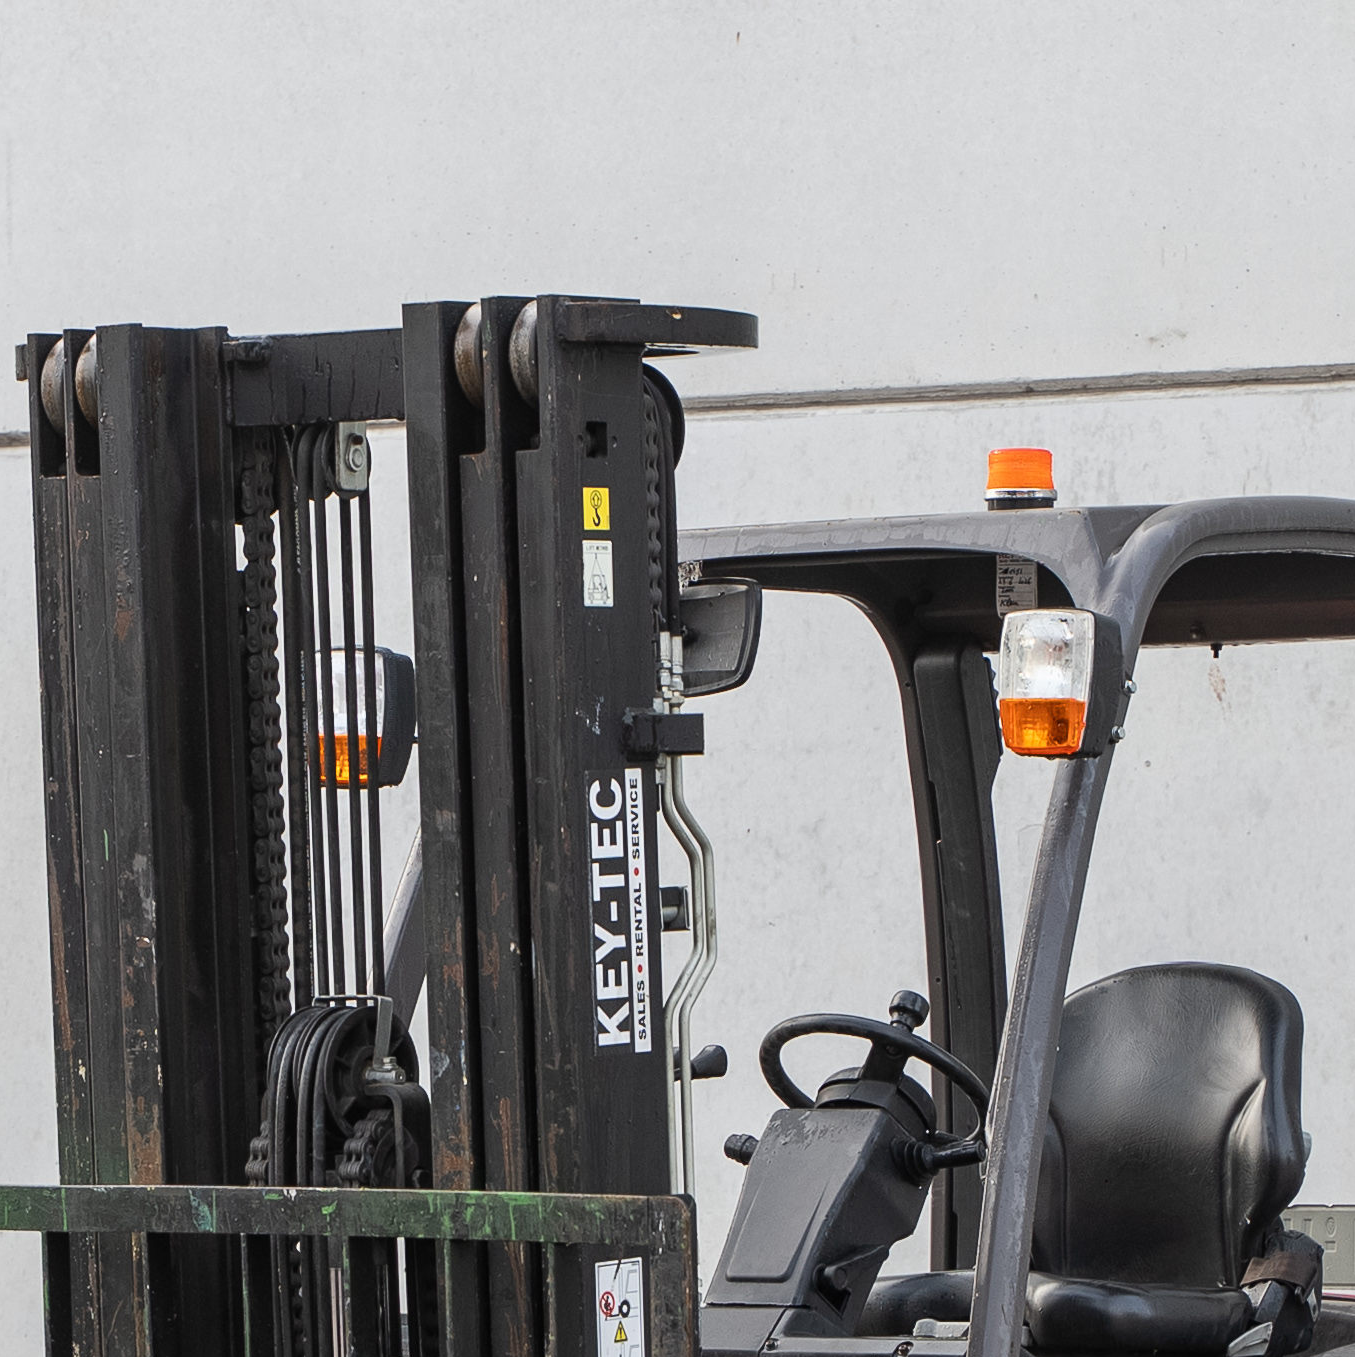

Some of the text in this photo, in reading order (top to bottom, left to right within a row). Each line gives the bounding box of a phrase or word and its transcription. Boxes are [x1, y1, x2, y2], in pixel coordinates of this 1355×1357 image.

[589, 777, 631, 1047] KEY-TEC
[629, 777, 648, 1041] SALES RENTAL SERVICE
